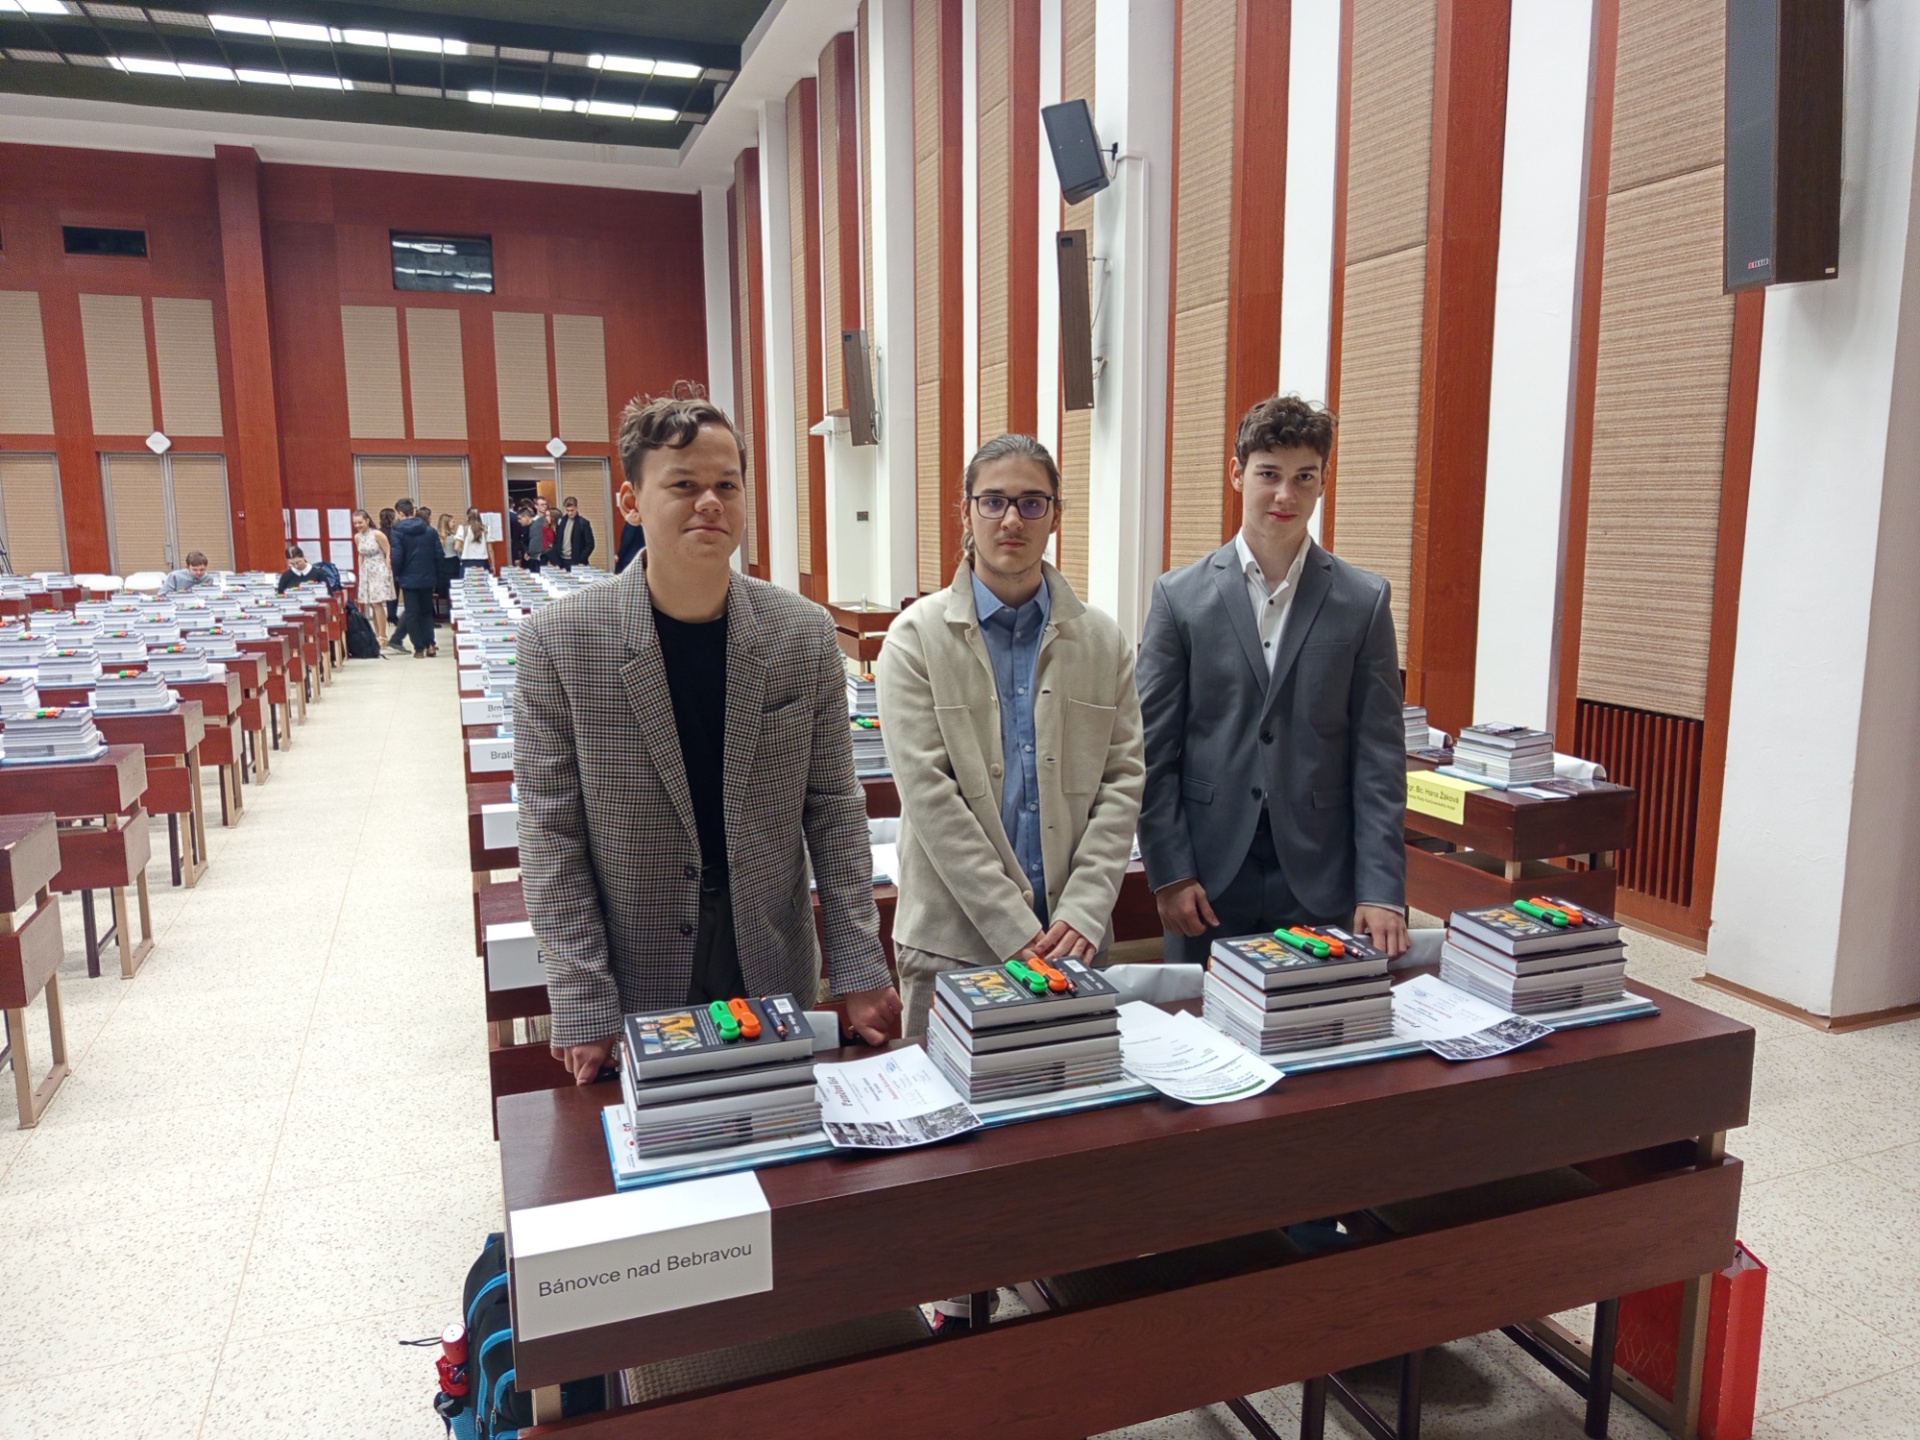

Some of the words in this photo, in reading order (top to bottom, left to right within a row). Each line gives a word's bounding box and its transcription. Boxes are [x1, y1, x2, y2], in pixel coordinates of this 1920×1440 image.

[487, 704, 503, 712] Brn
[490, 750, 513, 760] Brati
[538, 1269, 621, 1297] Bánovce
[626, 1258, 661, 1280] nad
[667, 1244, 752, 1271] Bebravou
